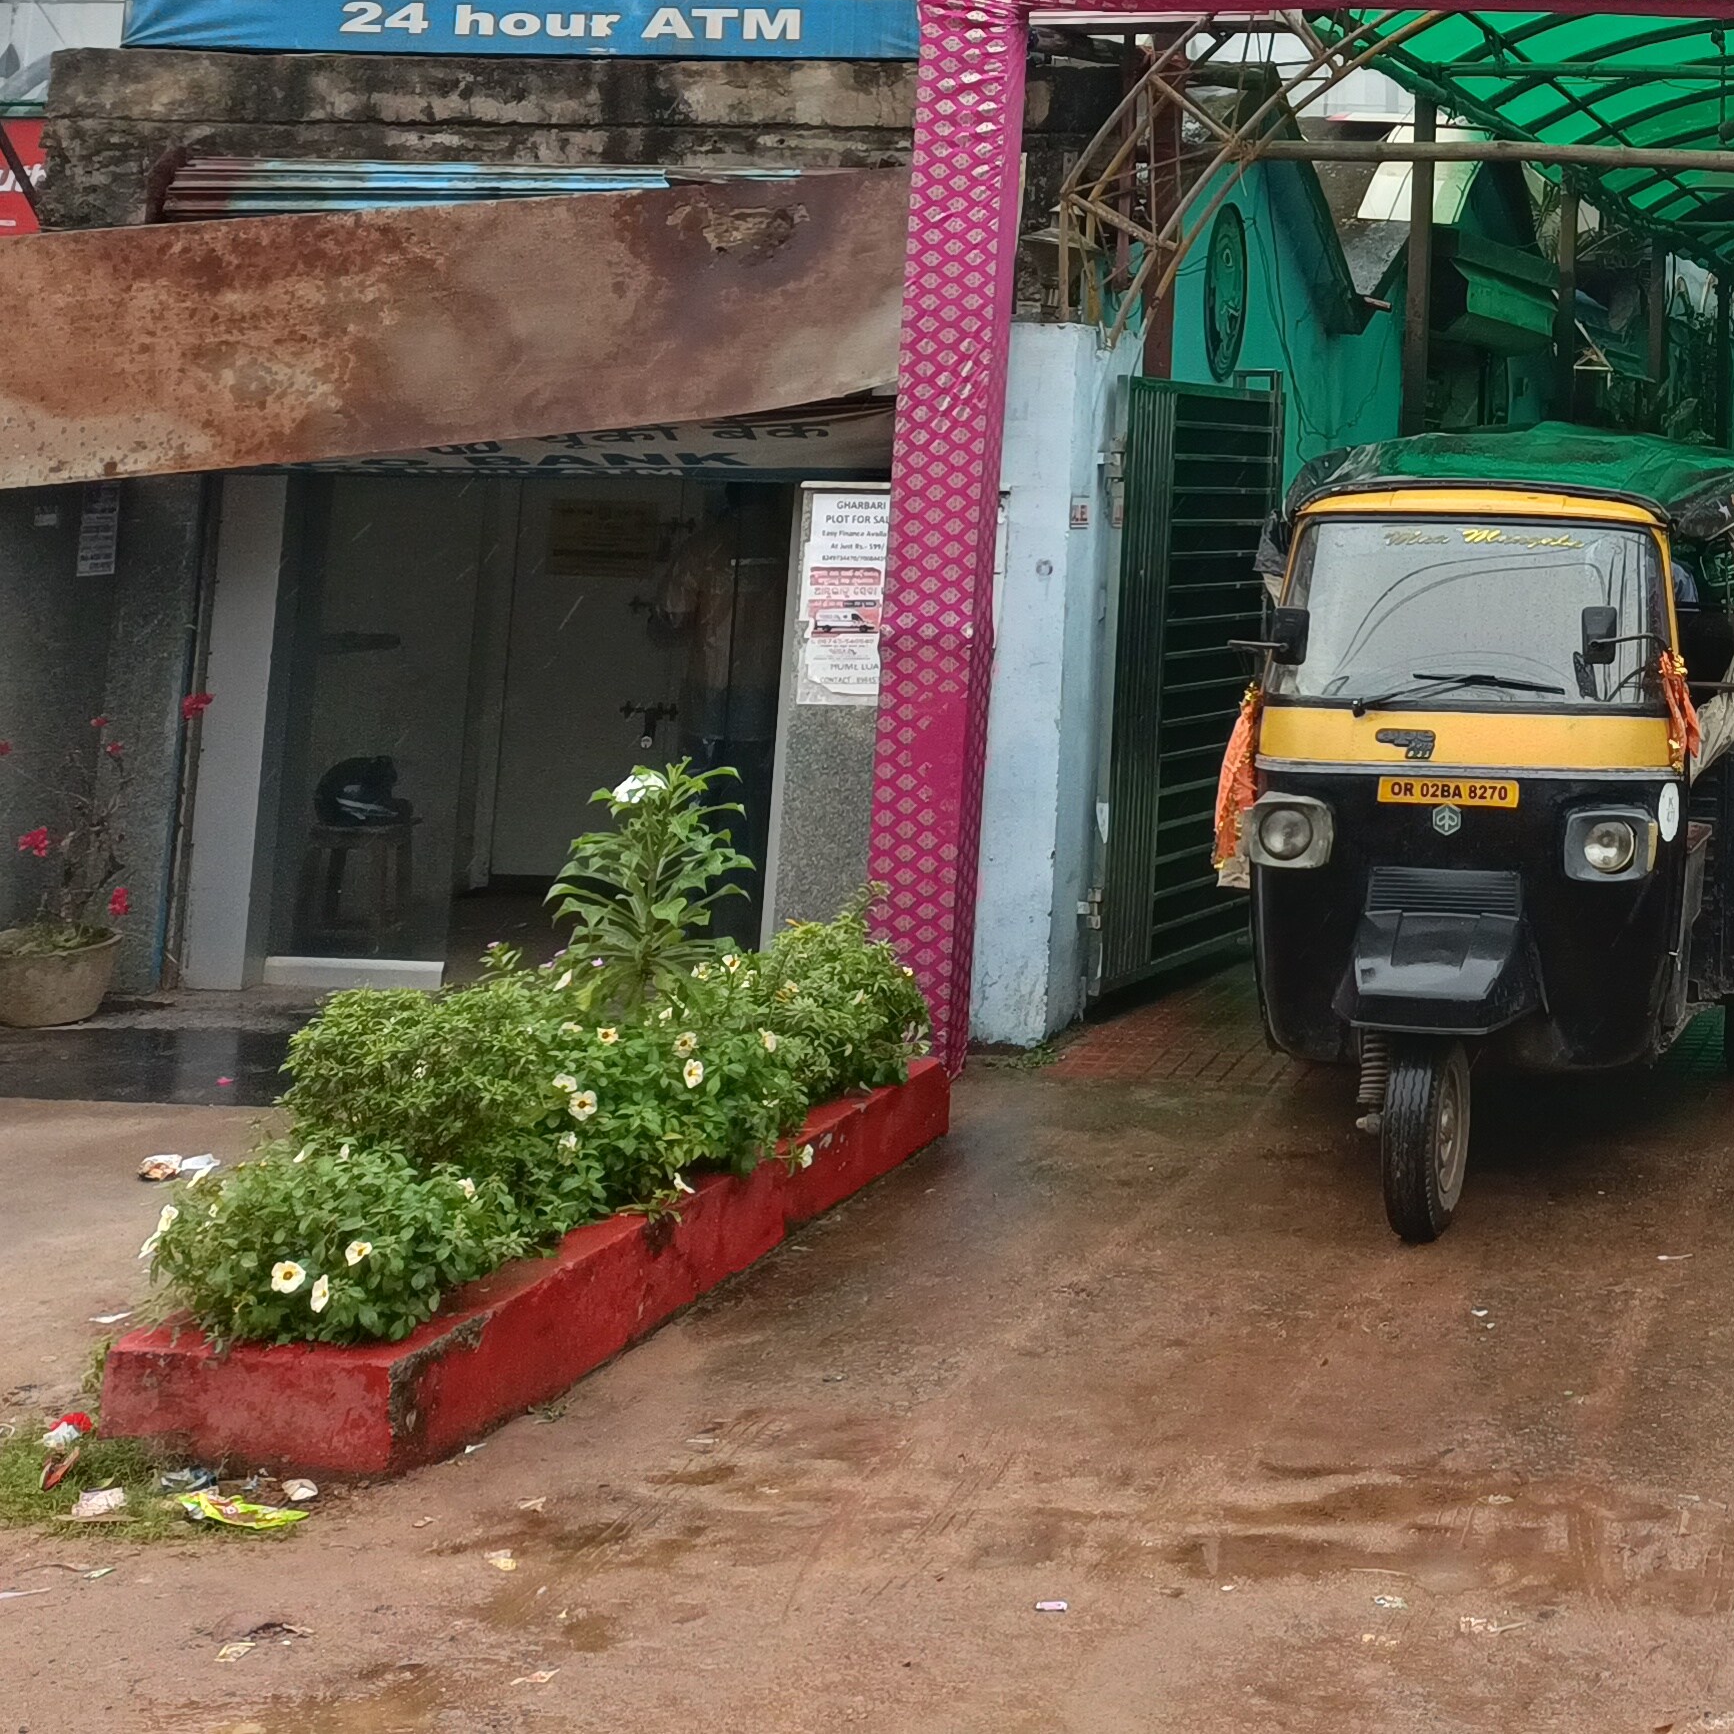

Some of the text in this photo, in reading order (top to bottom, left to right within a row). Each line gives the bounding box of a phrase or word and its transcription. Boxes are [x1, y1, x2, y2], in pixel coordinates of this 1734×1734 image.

[339, 1, 802, 41] 24 hour ATM
[836, 500, 886, 510] GHARBARI
[825, 514, 850, 524] PLOT
[852, 514, 871, 524] FOR
[1391, 781, 1508, 801] OR 02BA 8270
